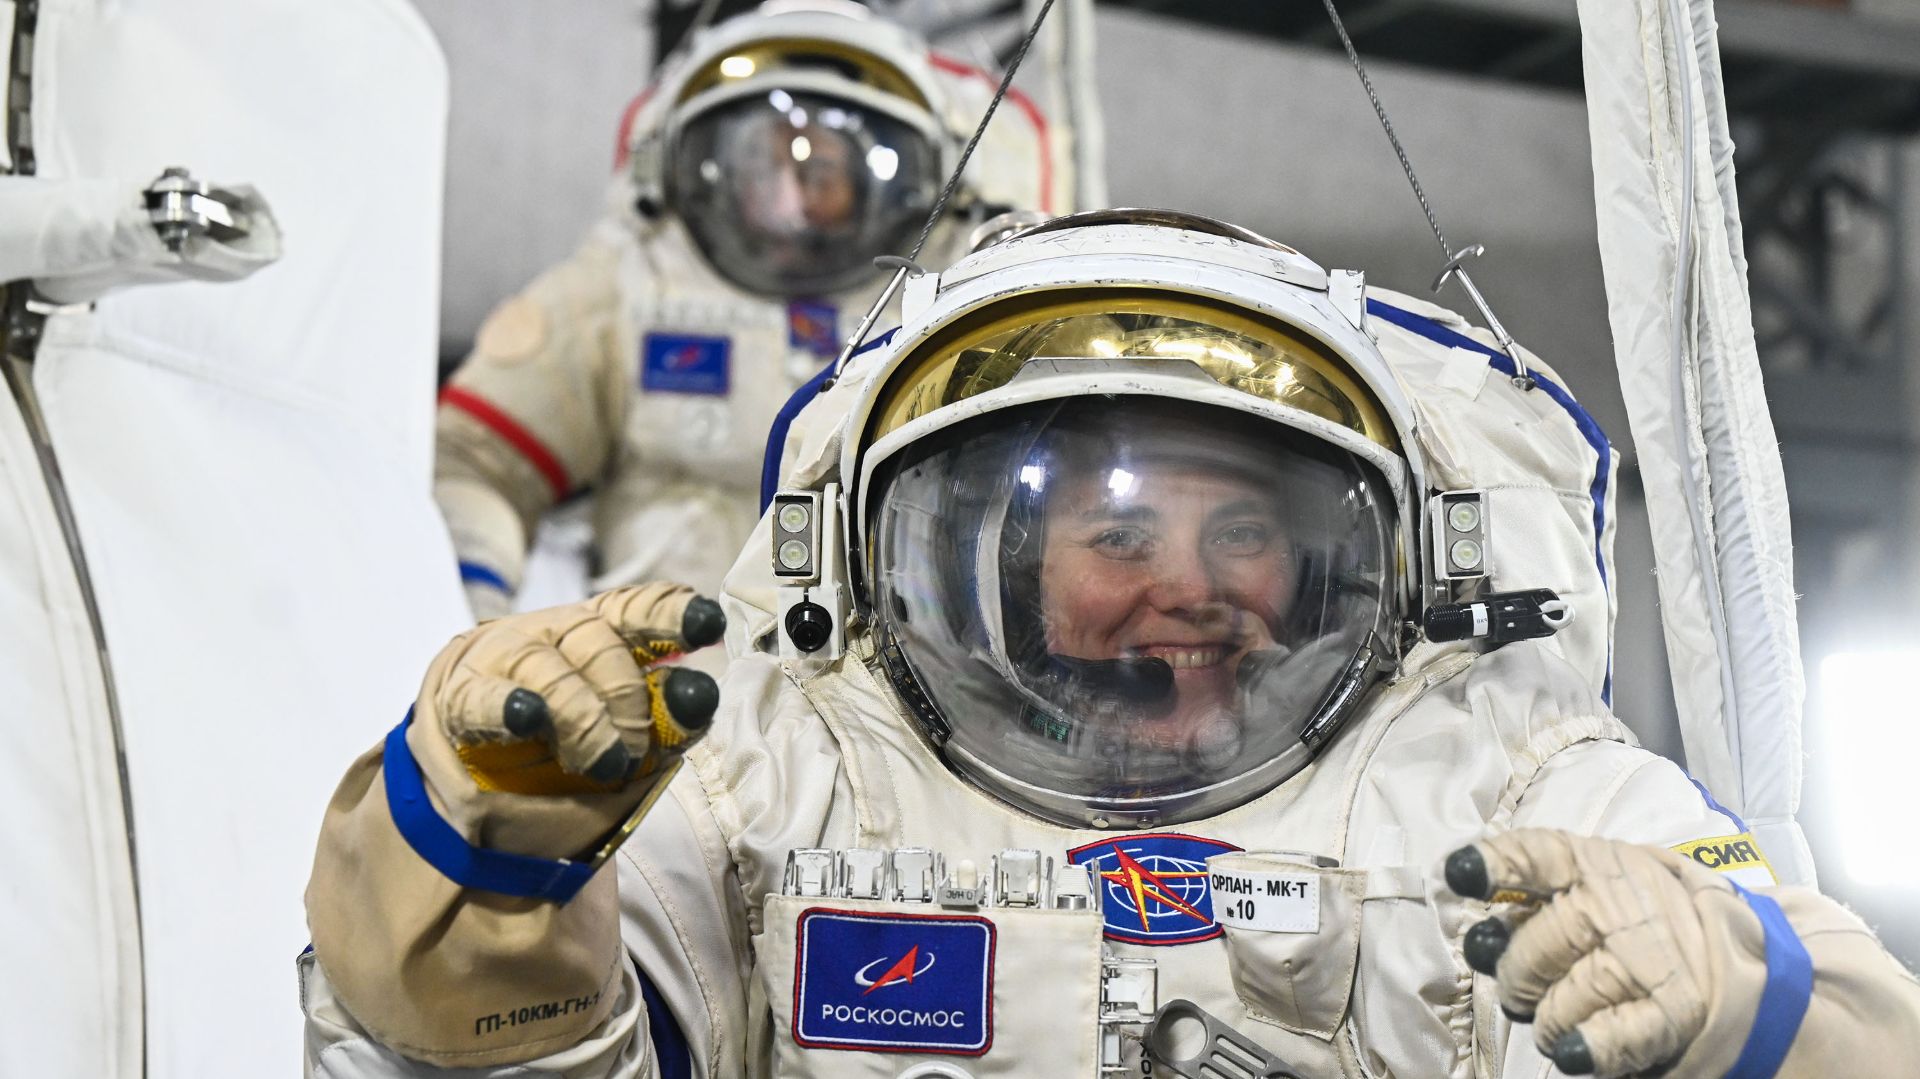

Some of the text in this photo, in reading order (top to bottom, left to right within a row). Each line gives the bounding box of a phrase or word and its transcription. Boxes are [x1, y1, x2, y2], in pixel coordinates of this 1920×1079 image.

[1681, 841, 1760, 868] СИЯ
[1211, 874, 1252, 895] ОРЛАН
[1267, 880, 1308, 898] МК-Т
[1236, 899, 1255, 920] 10
[822, 1004, 965, 1027] РОСКОСМОС
